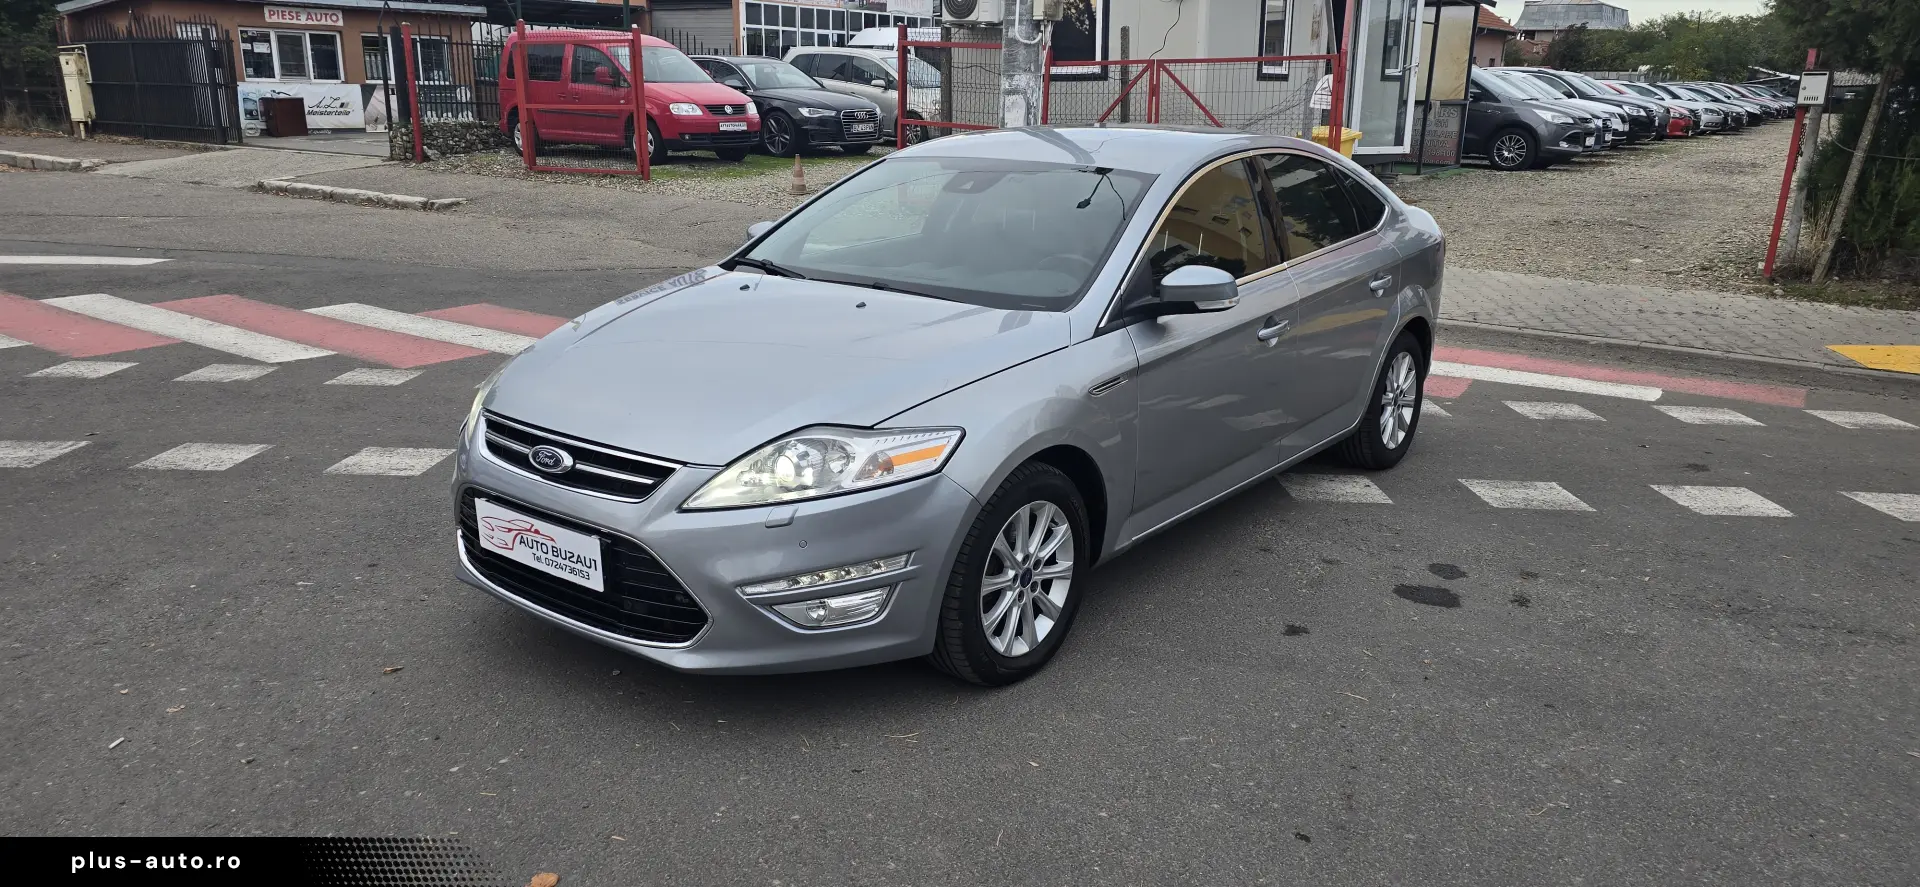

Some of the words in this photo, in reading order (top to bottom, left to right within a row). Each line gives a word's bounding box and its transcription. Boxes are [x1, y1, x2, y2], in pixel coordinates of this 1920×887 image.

[268, 9, 302, 21] PIESE
[305, 11, 340, 23] AUTO
[535, 450, 556, 466] Ford
[519, 534, 549, 555] AUTO
[532, 552, 545, 564] Tel.
